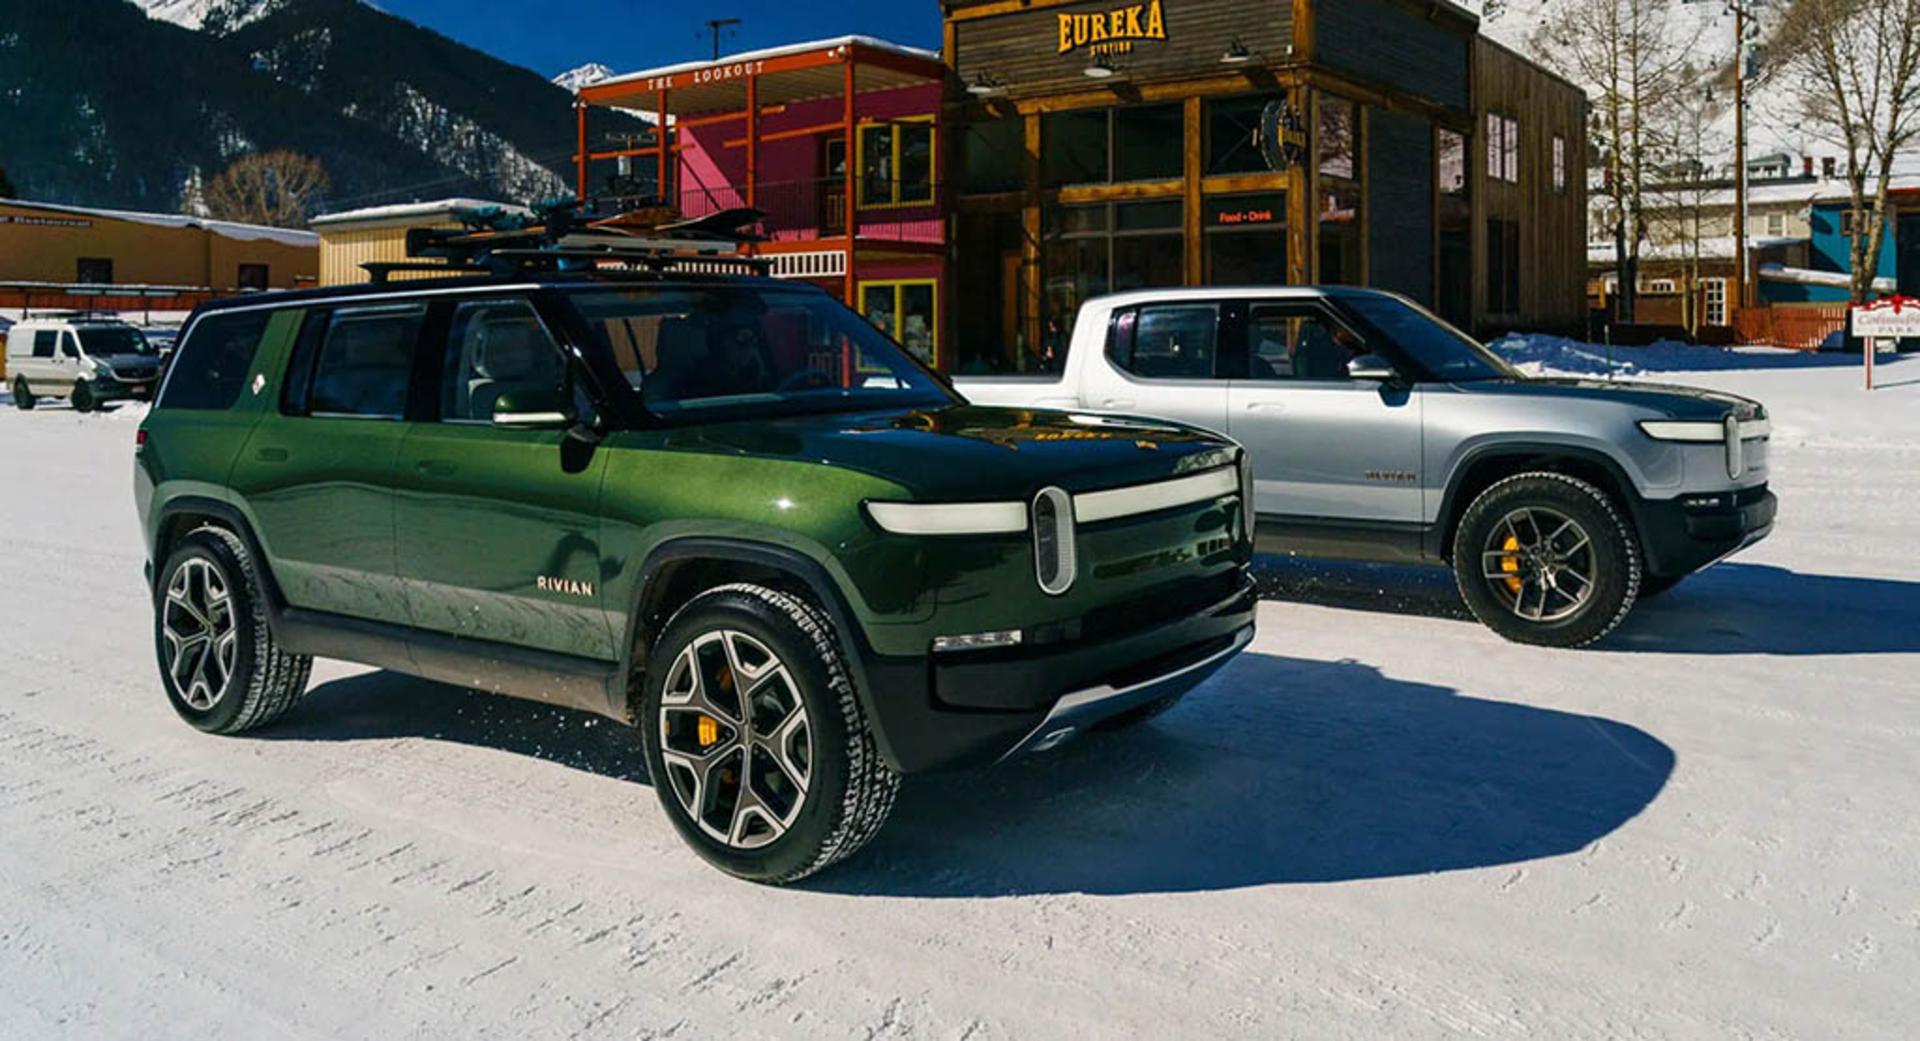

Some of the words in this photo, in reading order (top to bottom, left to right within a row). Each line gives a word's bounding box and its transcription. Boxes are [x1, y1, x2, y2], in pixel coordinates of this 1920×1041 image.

[1057, 0, 1167, 53] EUREKA
[648, 76, 673, 91] THE
[694, 61, 763, 83] LOOKOUT
[1219, 212, 1241, 223] Food
[1248, 210, 1271, 221] Drink
[537, 576, 593, 597] RIVIAN
